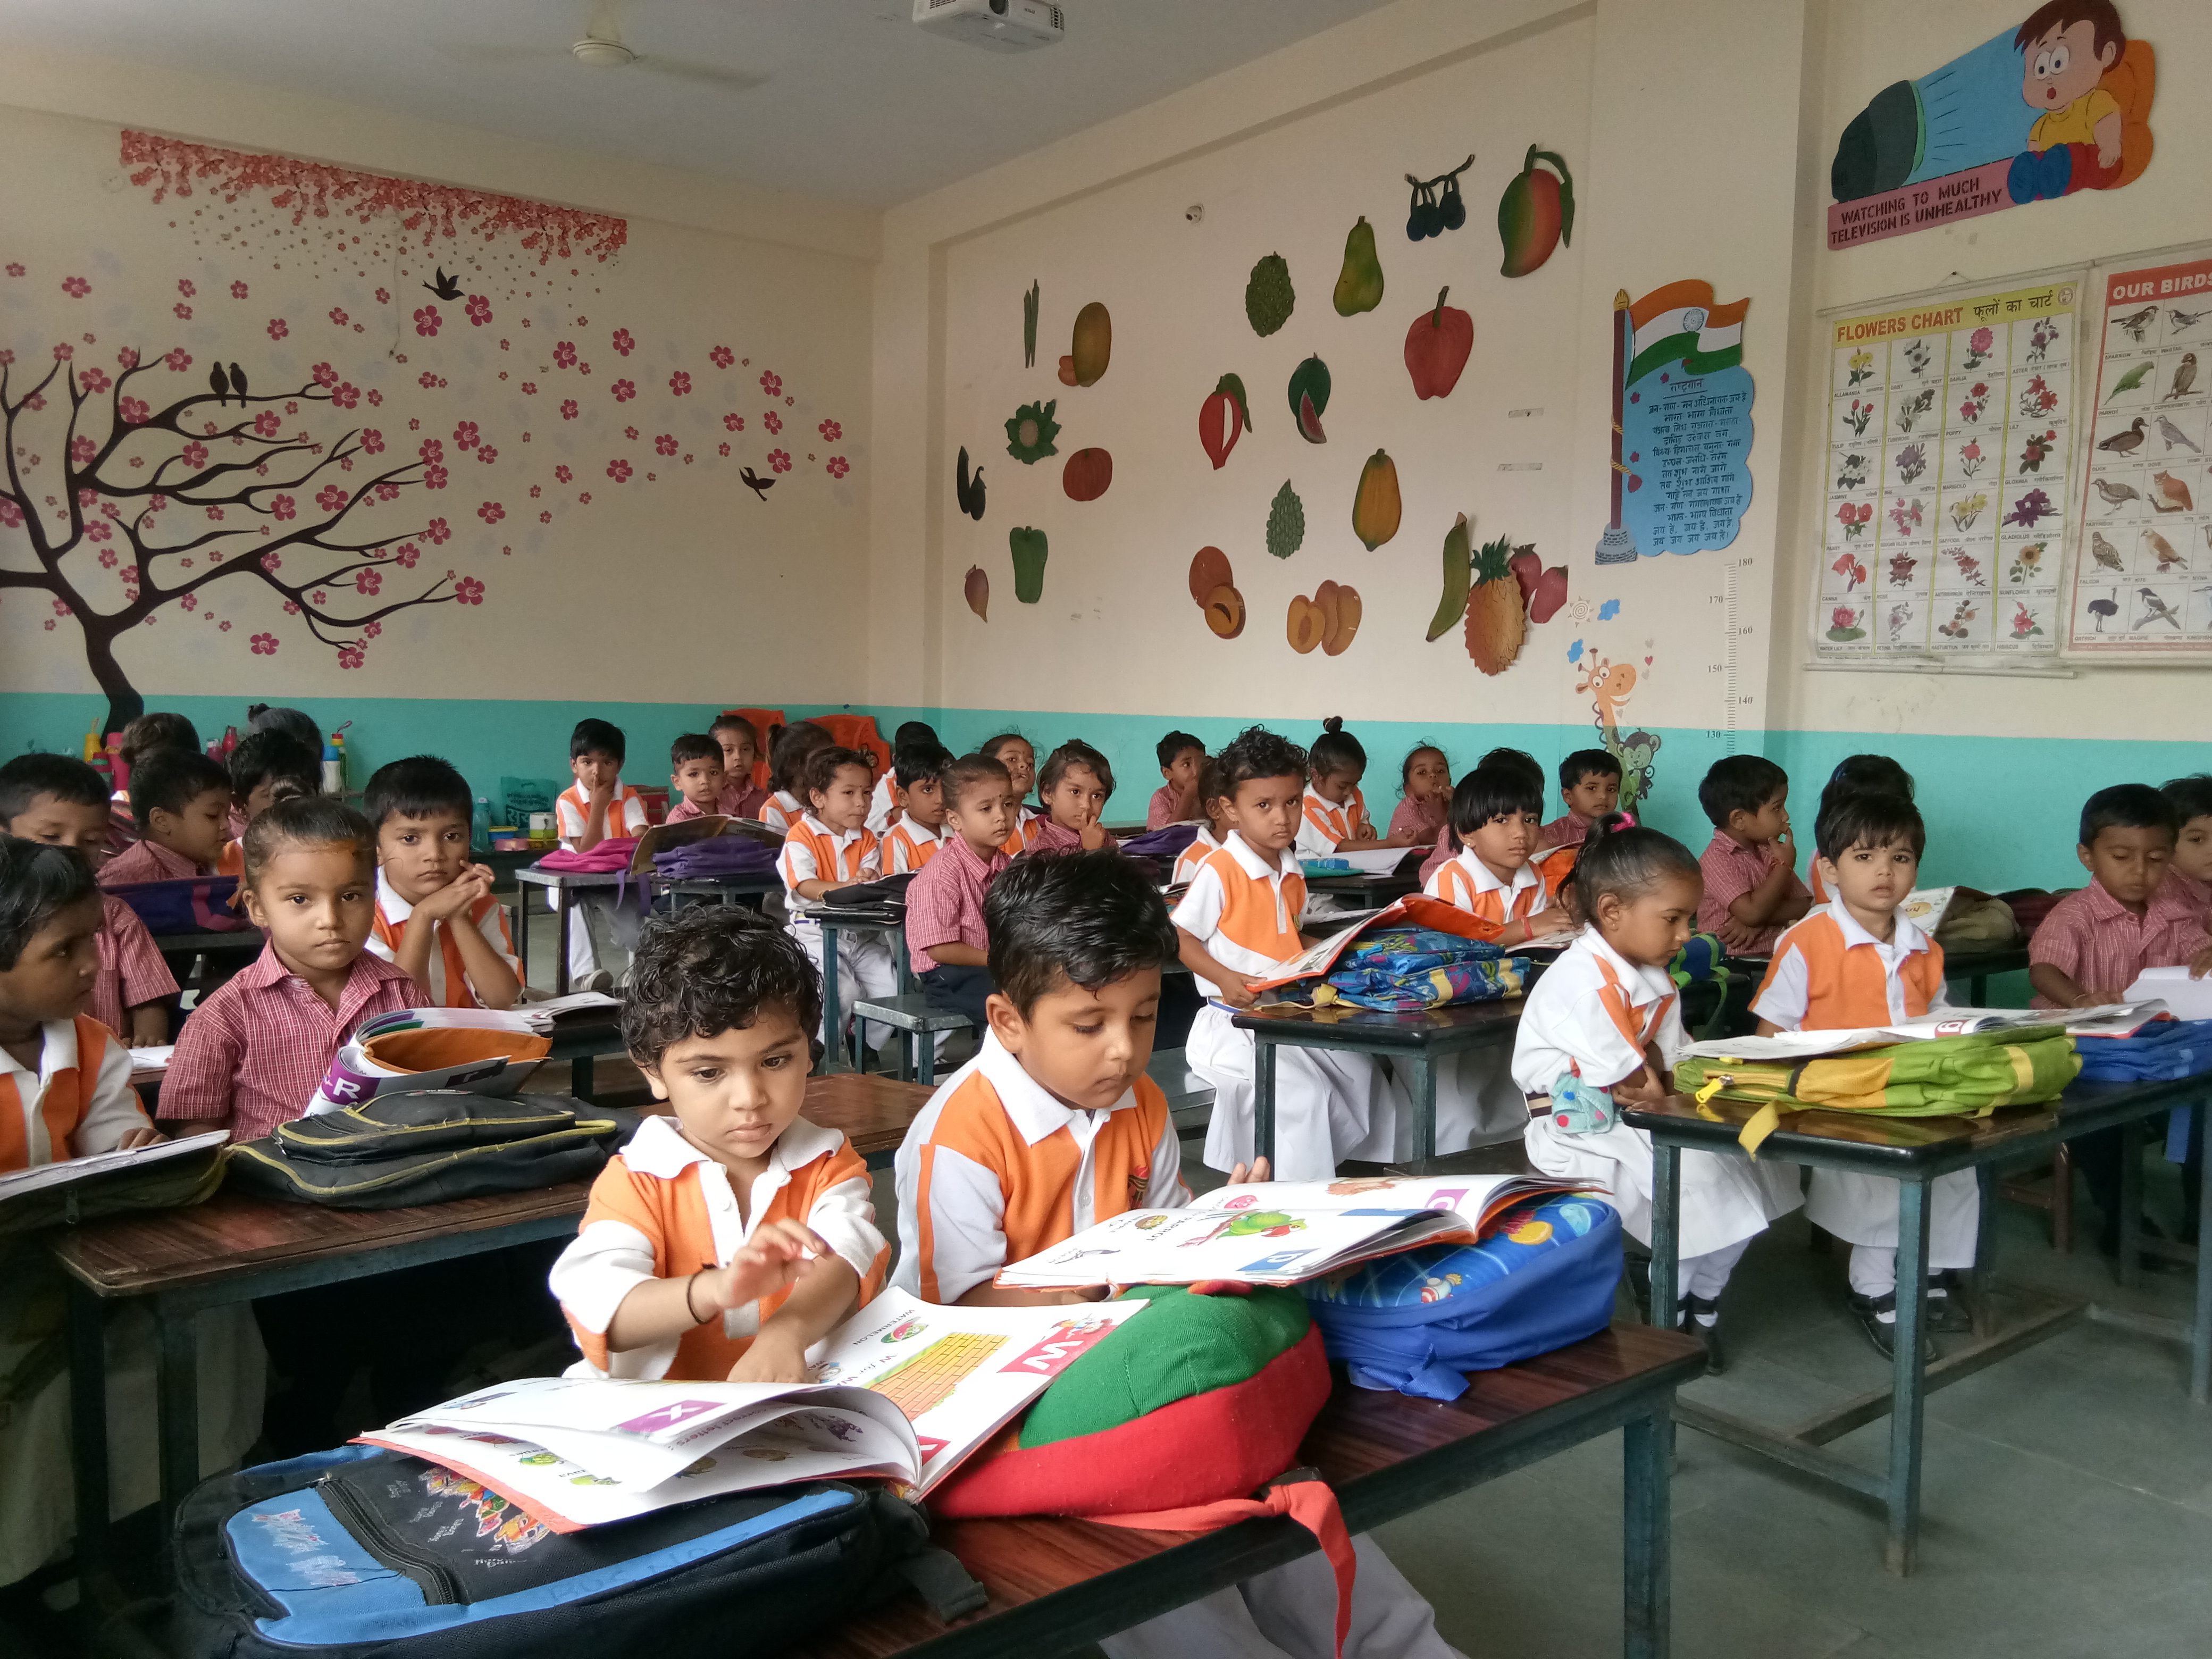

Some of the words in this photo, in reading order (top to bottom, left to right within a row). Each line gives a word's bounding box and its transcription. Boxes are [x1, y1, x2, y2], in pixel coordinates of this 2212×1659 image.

[1841, 197, 1905, 224] WATCHING
[1913, 191, 1929, 207] TO
[1939, 177, 1979, 199] MUCH
[1831, 216, 1897, 244] TELEVISION
[1901, 213, 1910, 227] IS
[1915, 189, 2002, 223] UNHEALTHY
[2113, 282, 2154, 299] OUR
[1974, 298, 2001, 322] फूलों
[2006, 299, 2023, 312] का
[2028, 290, 2054, 309] चार्ट
[1838, 316, 1906, 342] FLOWERS
[1912, 307, 1963, 330] CHART
[1738, 558, 1753, 567] 180
[1738, 626, 1753, 635] 160
[1738, 696, 1753, 704] 140
[333, 1077, 361, 1100] R
[1145, 1217, 1193, 1242] PARROT
[852, 1309, 916, 1346] WATERMELON
[1021, 1340, 1084, 1371] W
[859, 1362, 876, 1375] for
[675, 1424, 722, 1447] letters
